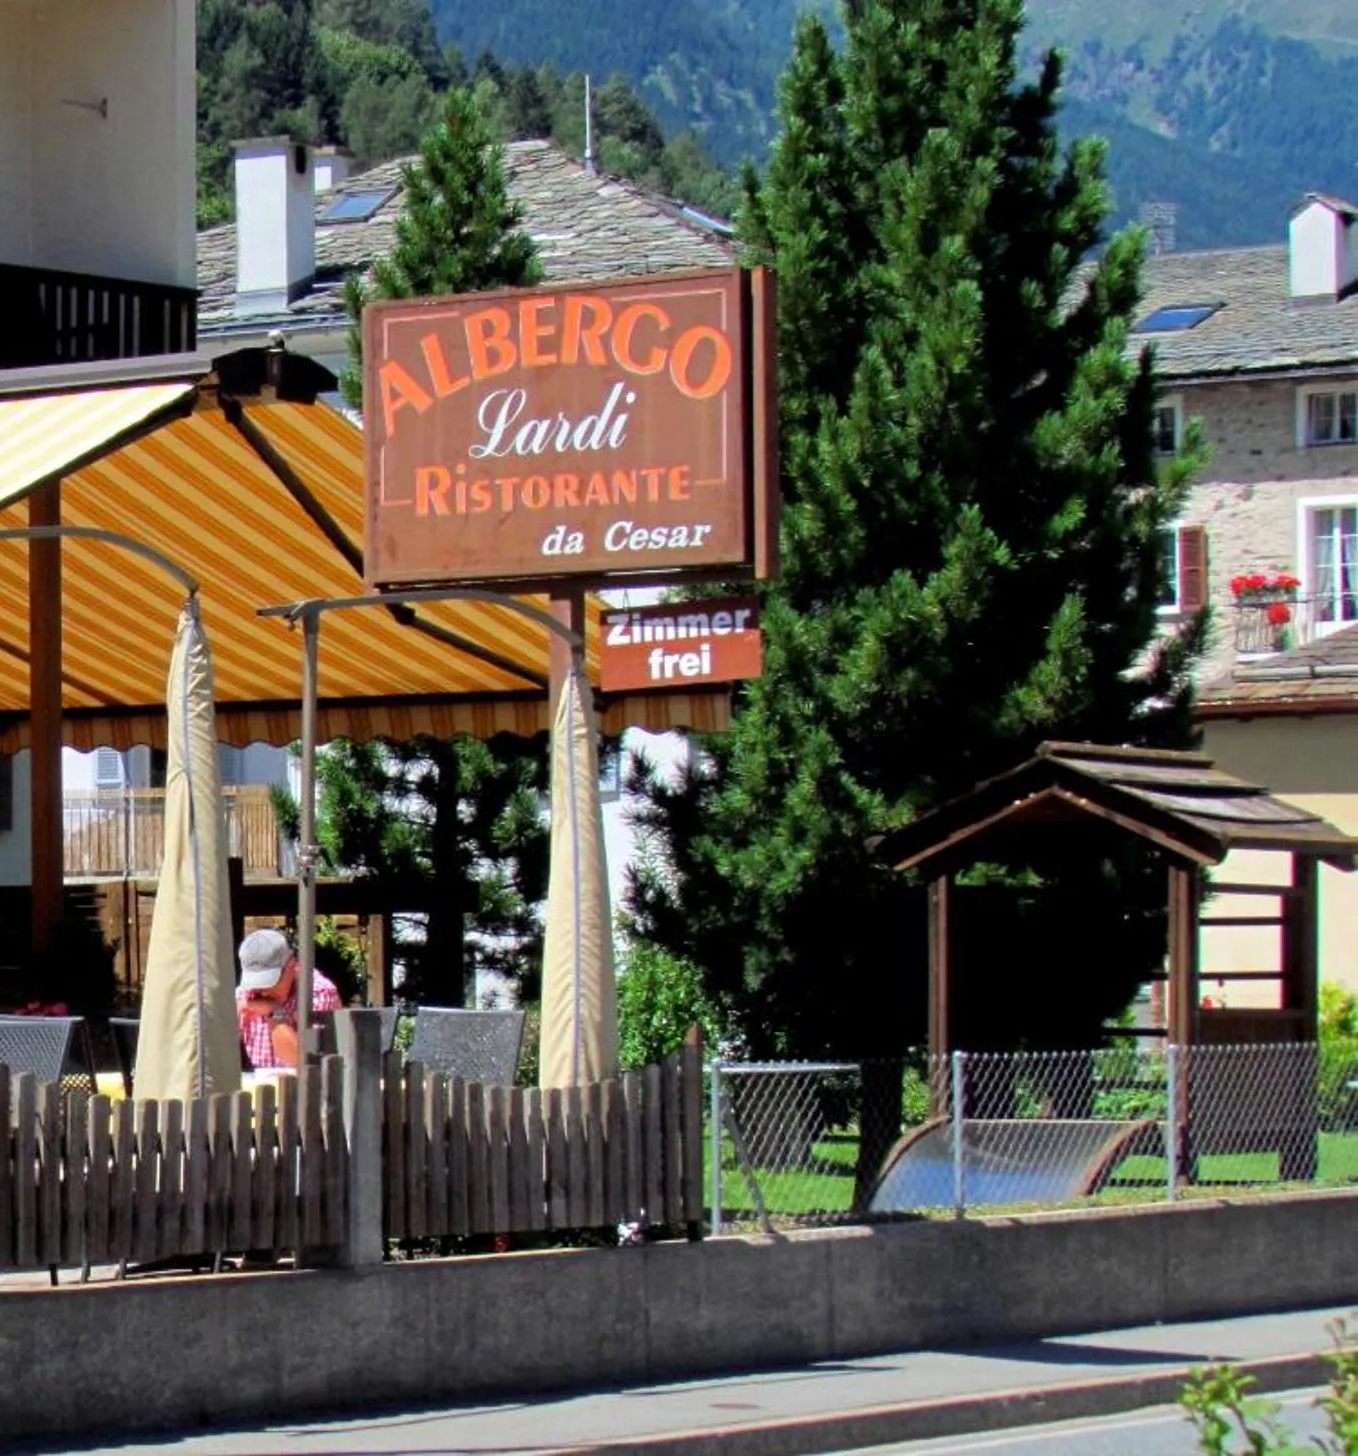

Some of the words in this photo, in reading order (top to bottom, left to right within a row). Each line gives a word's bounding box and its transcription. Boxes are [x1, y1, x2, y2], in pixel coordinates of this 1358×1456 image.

[378, 296, 732, 438] ALBERGO
[469, 380, 636, 459] Lardi
[541, 525, 584, 556] da
[604, 519, 712, 553] Cesar
[606, 605, 751, 647] Zimmer
[649, 644, 712, 680] frei
